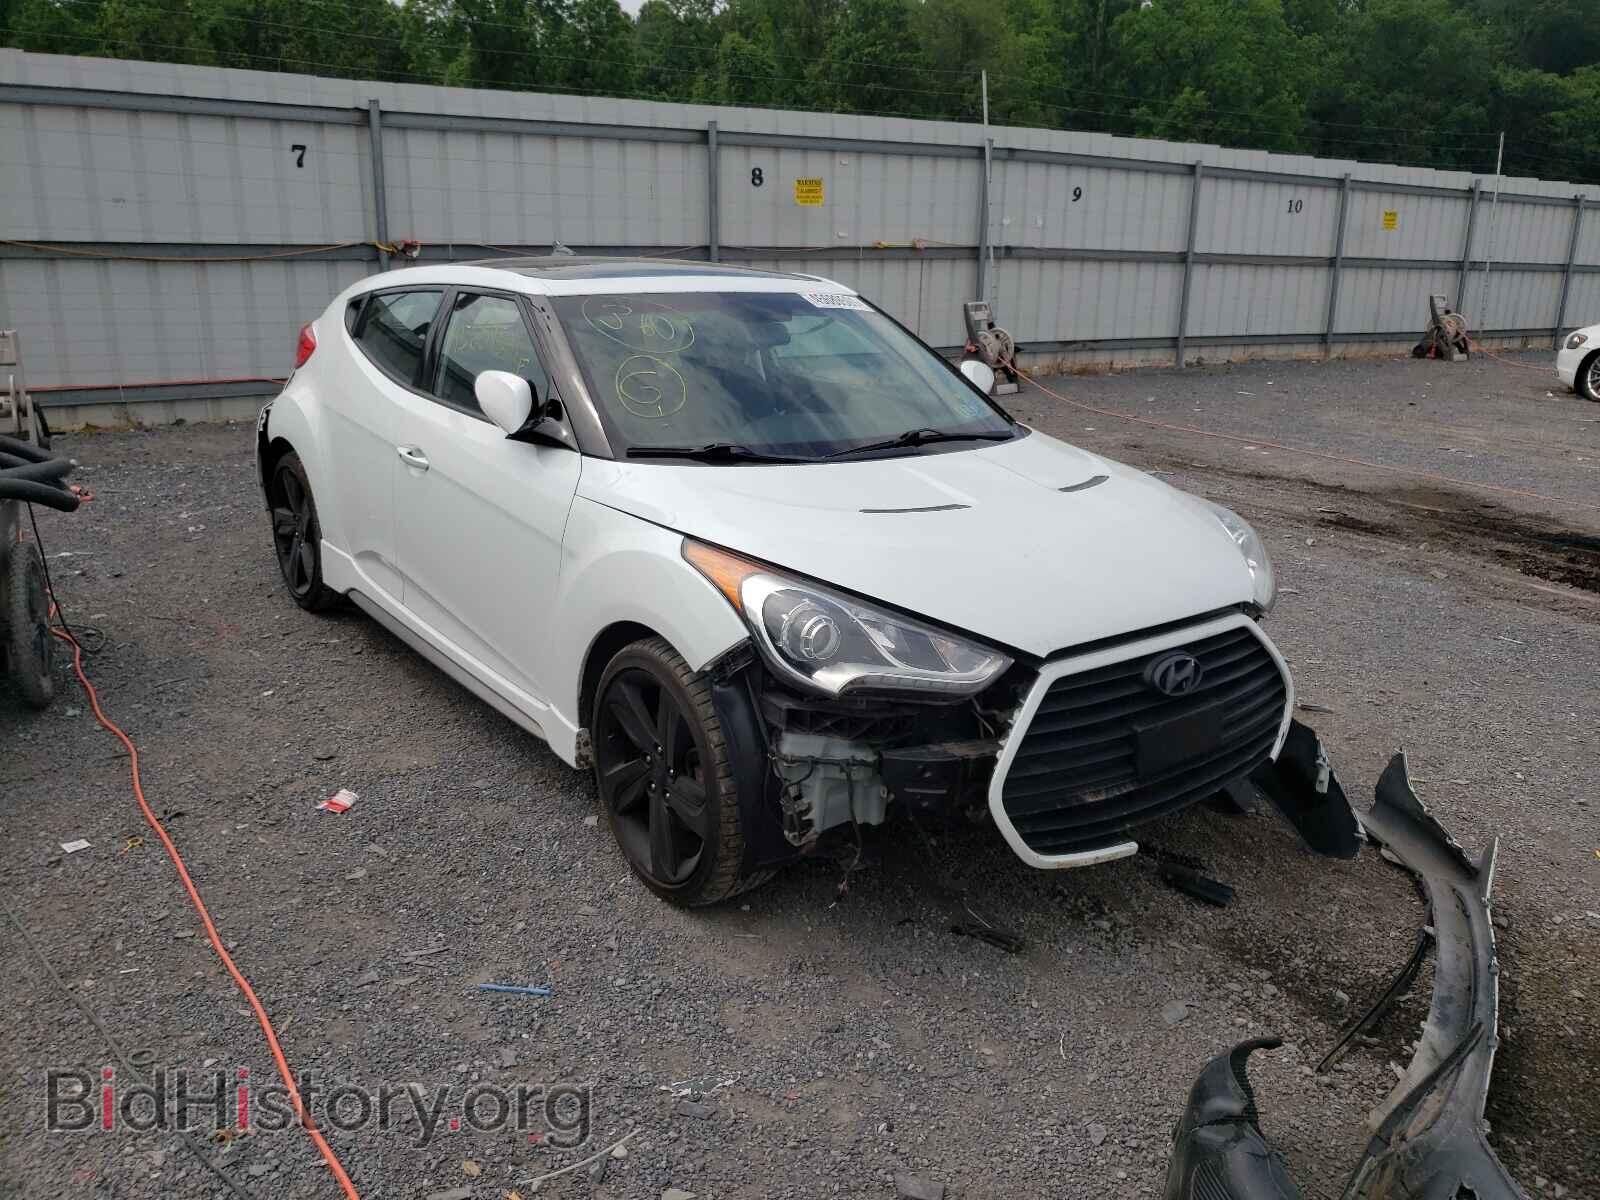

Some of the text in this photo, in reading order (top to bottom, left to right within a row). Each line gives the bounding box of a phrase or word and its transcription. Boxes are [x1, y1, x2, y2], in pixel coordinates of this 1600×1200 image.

[291, 144, 306, 168] 7
[751, 167, 763, 187] 8
[1071, 186, 1082, 202] 9
[1286, 199, 1303, 214] 10
